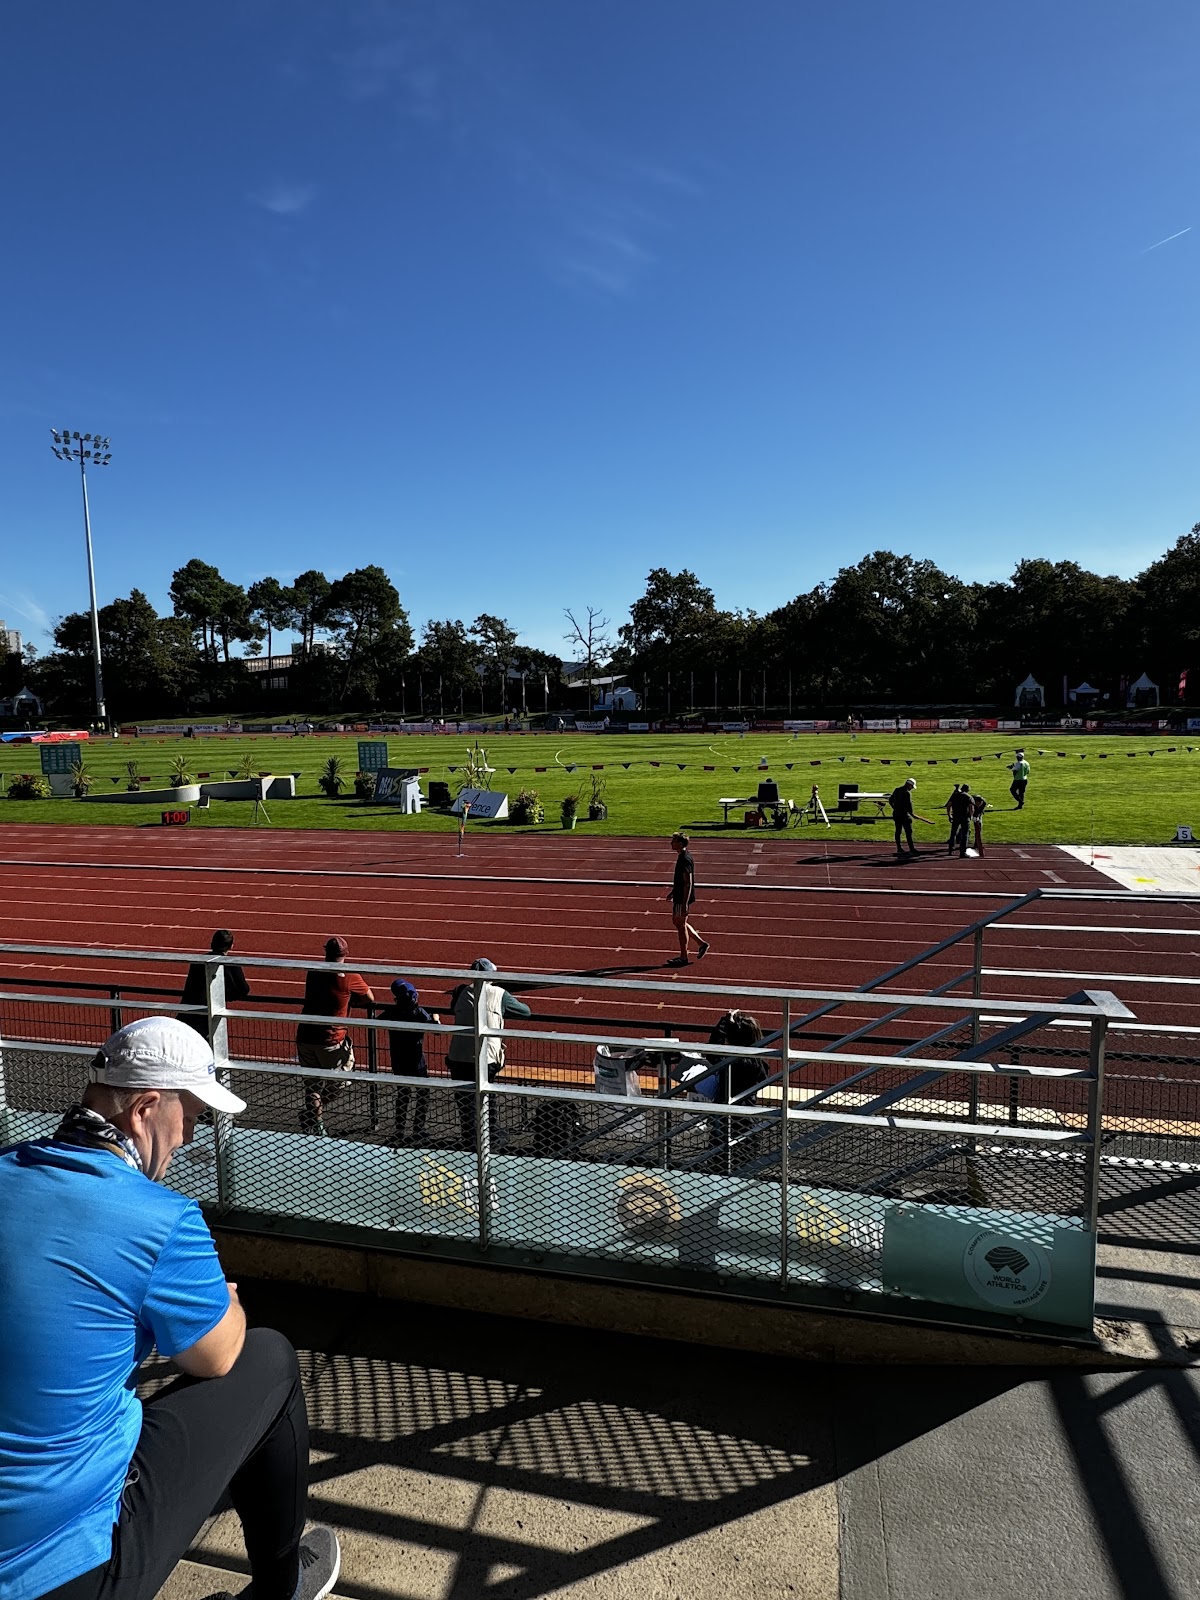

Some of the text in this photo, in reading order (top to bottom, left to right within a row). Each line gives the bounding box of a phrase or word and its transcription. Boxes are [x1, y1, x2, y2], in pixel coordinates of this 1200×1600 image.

[164, 811, 187, 823] 1:00
[1181, 830, 1188, 838] 5
[993, 1274, 1021, 1284] WORLD
[986, 1280, 1027, 1291] ATHLETICS
[1013, 1279, 1048, 1305] HERITAGE SITE
